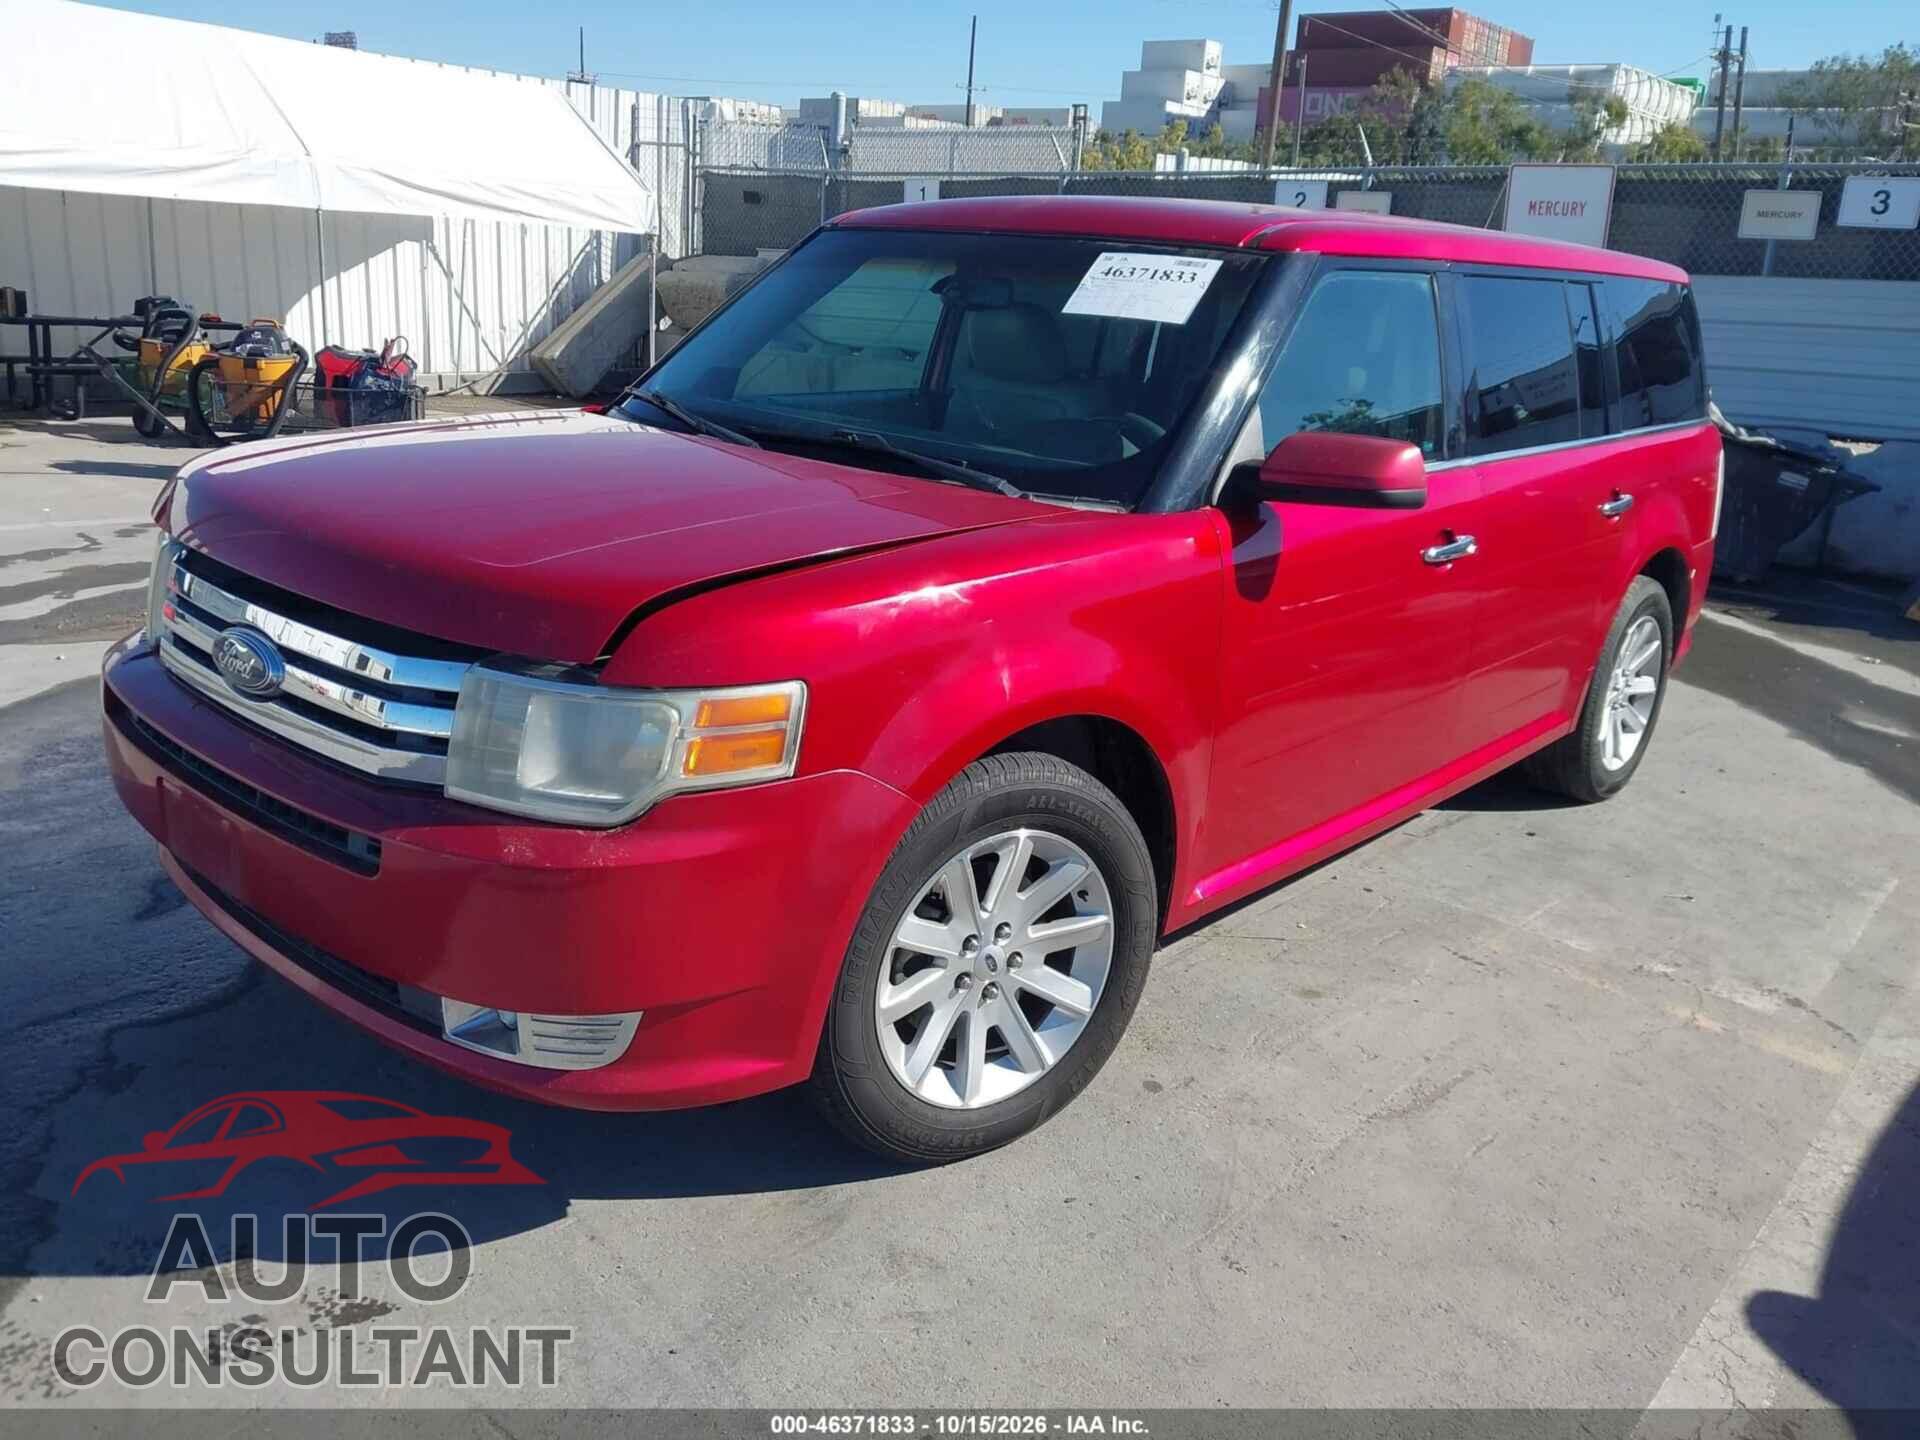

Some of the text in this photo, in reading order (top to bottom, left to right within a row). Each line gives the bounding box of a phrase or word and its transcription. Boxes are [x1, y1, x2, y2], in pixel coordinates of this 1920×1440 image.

[919, 186, 926, 201] 1
[1295, 191, 1307, 208] 2
[1870, 189, 1892, 215] 3
[1528, 200, 1588, 216] MERCURY
[1757, 208, 1804, 219] MERCURY
[1100, 265, 1198, 284] 46371833
[219, 639, 256, 679] Ford
